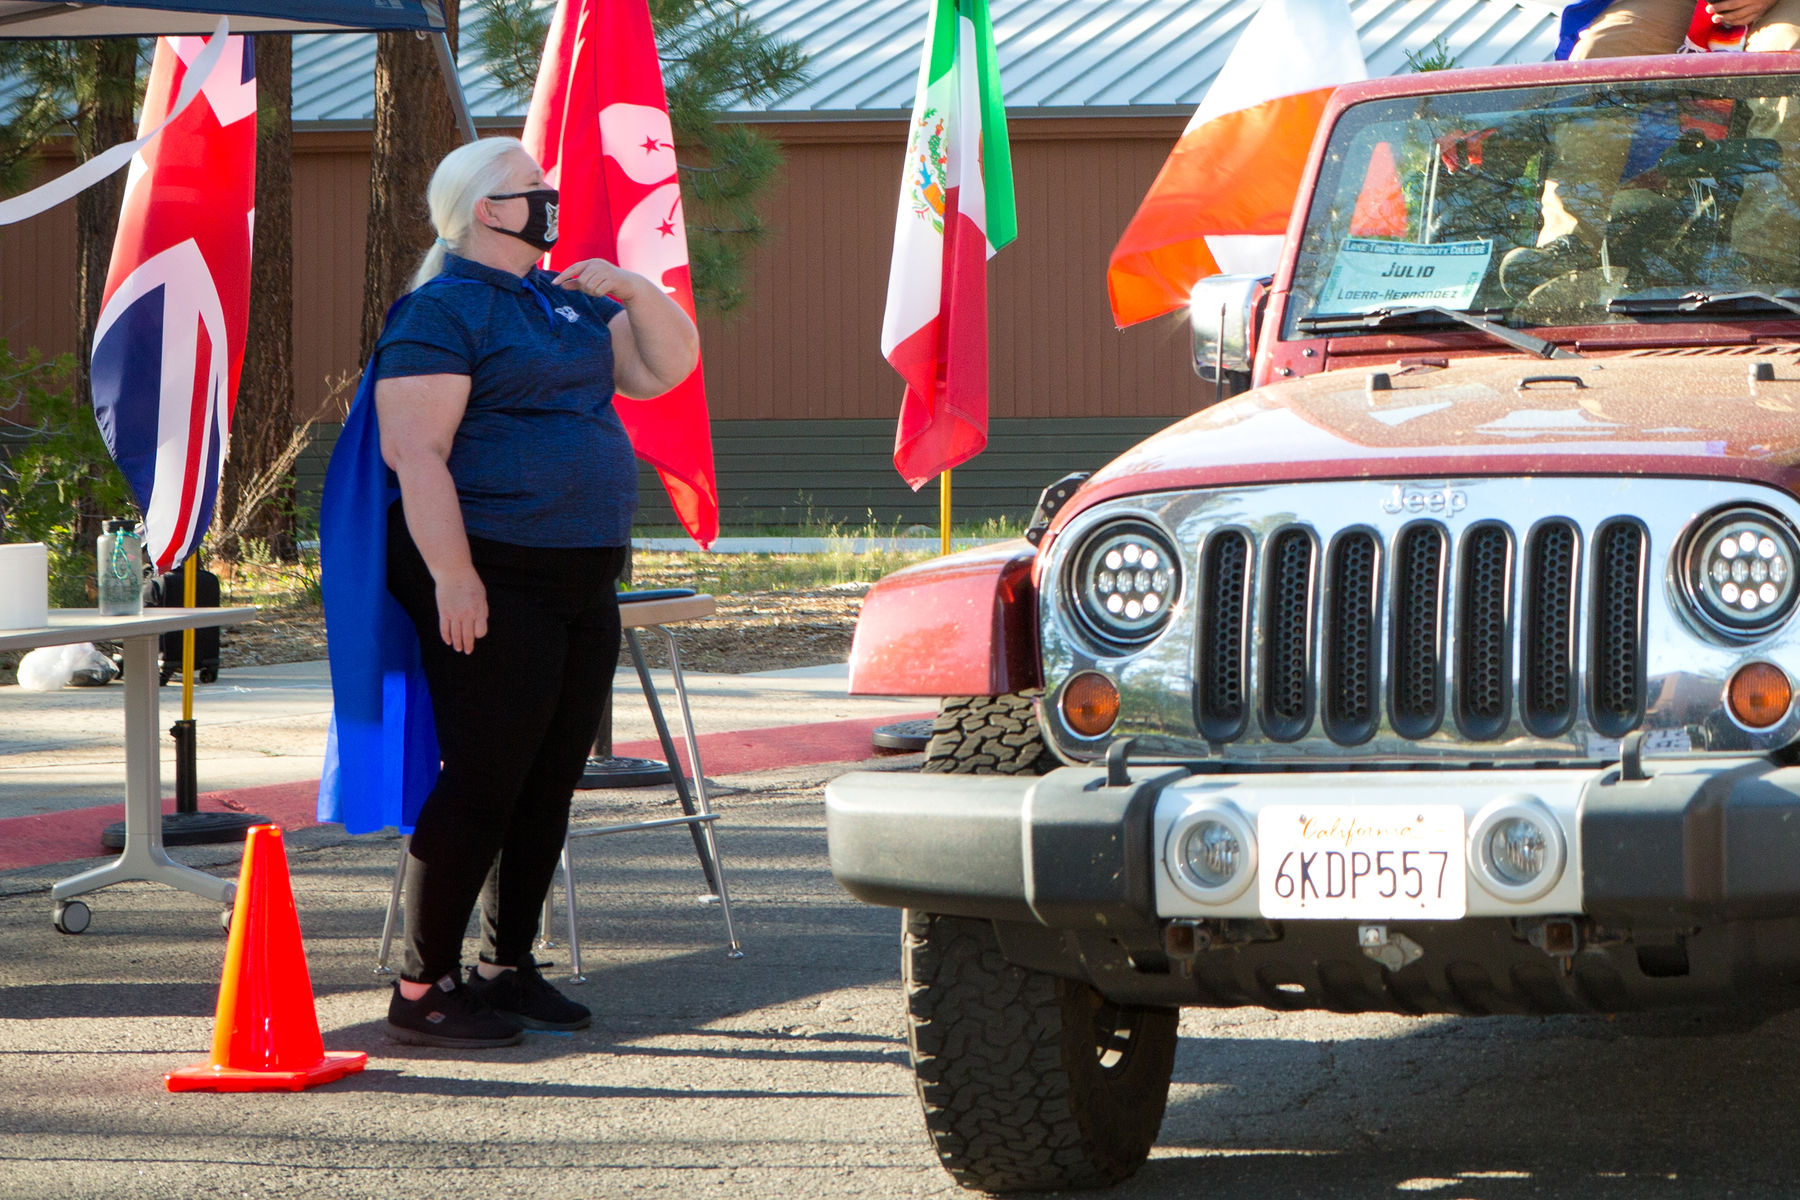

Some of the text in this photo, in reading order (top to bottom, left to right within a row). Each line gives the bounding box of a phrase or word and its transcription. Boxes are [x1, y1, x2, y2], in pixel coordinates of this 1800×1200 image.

[1380, 262, 1436, 279] JULIO
[1382, 484, 1468, 518] Jeep
[1302, 815, 1413, 848] California
[1274, 850, 1449, 900] 6KDP557
